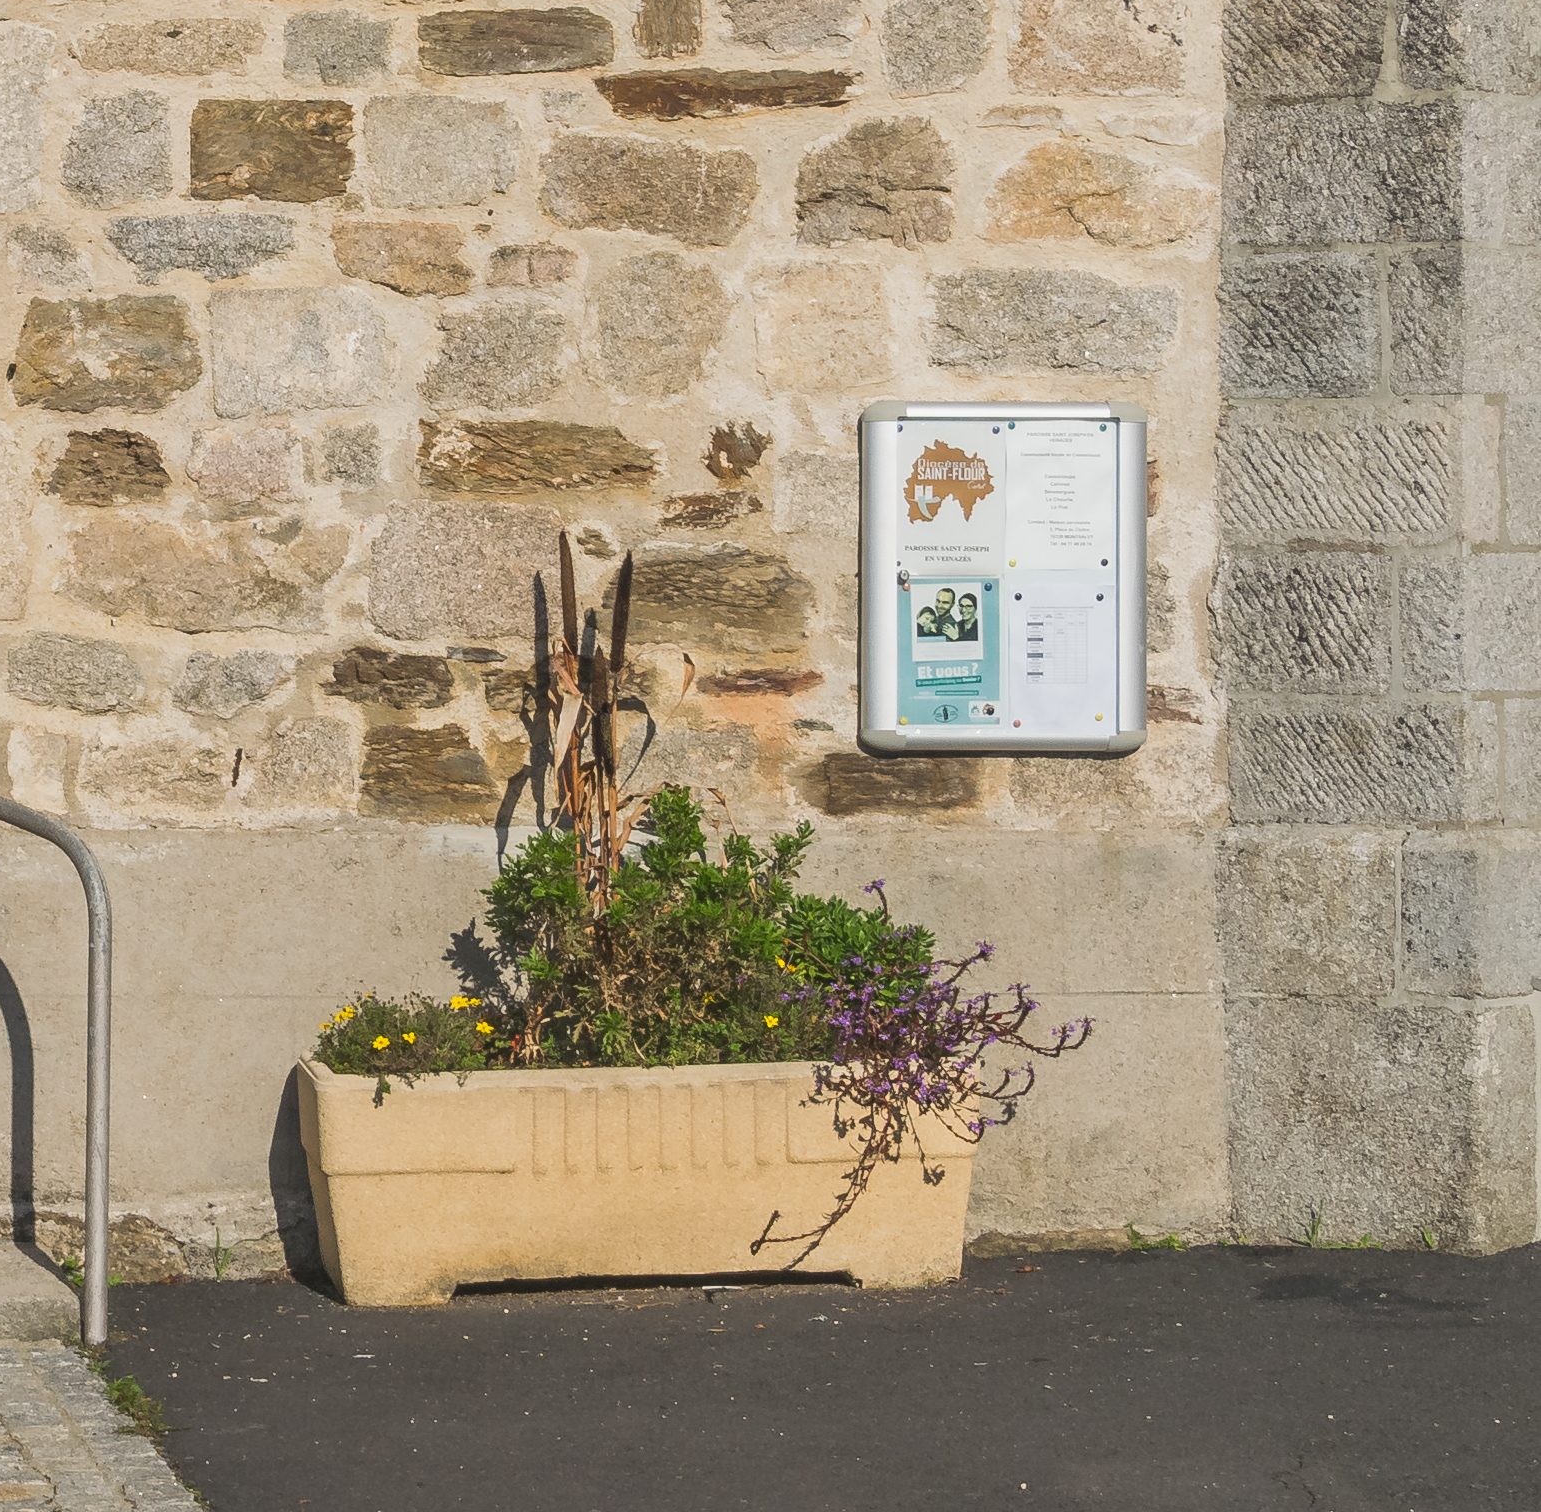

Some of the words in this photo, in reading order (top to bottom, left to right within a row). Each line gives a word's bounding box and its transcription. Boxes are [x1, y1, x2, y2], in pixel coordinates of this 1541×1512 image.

[918, 458, 966, 468] Diocèse
[970, 459, 984, 468] de
[917, 467, 985, 480] SAINT-FLOUR
[917, 665, 933, 679] Et
[936, 666, 969, 677] vous
[972, 662, 978, 675] ?
